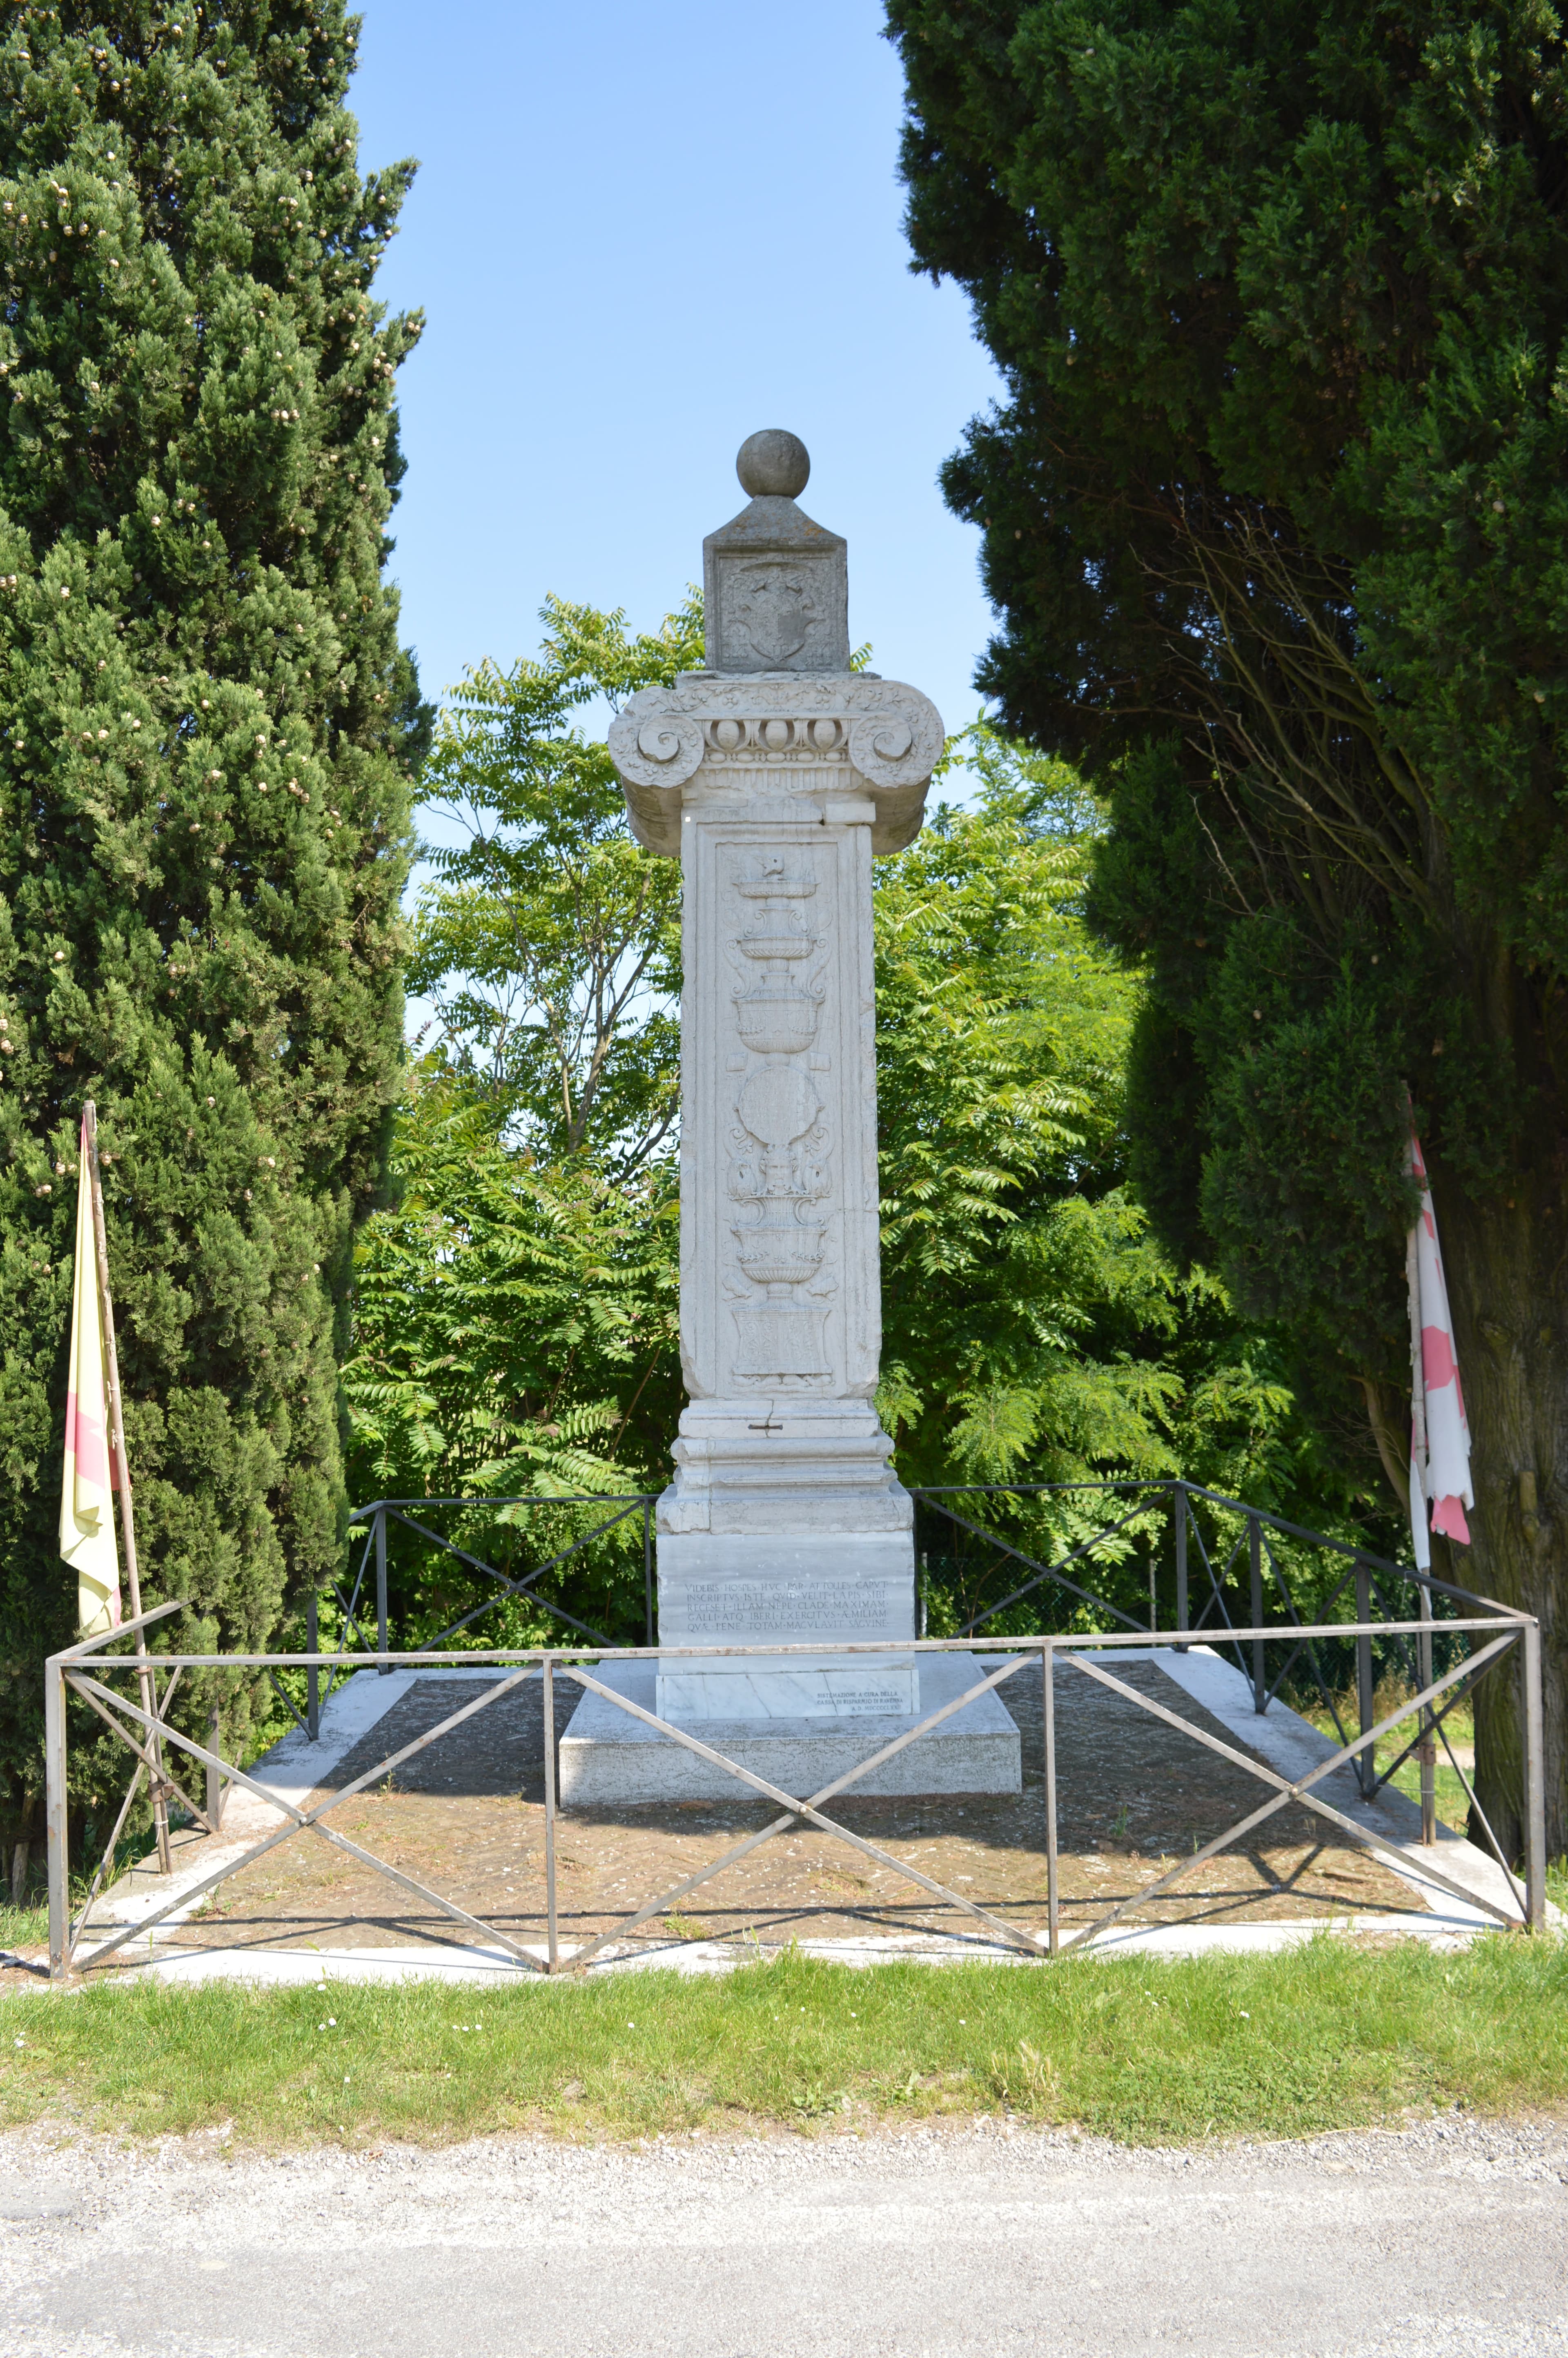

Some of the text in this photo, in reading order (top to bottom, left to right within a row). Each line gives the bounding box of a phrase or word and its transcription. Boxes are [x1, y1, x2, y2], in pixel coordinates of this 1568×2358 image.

[685, 1584, 719, 1592] VIDEBIS
[725, 1583, 756, 1592] HOSPES
[744, 1593, 765, 1601] ISTE
[773, 1592, 796, 1601] QVID
[833, 1591, 861, 1599] LAPIS
[833, 1600, 885, 1609] MAXIMAM
[751, 1612, 775, 1620] IBERI
[781, 1611, 835, 1620] EXERCITVS
[747, 1622, 782, 1630] TOTAM
[786, 1620, 844, 1630] MACVLAVIT
